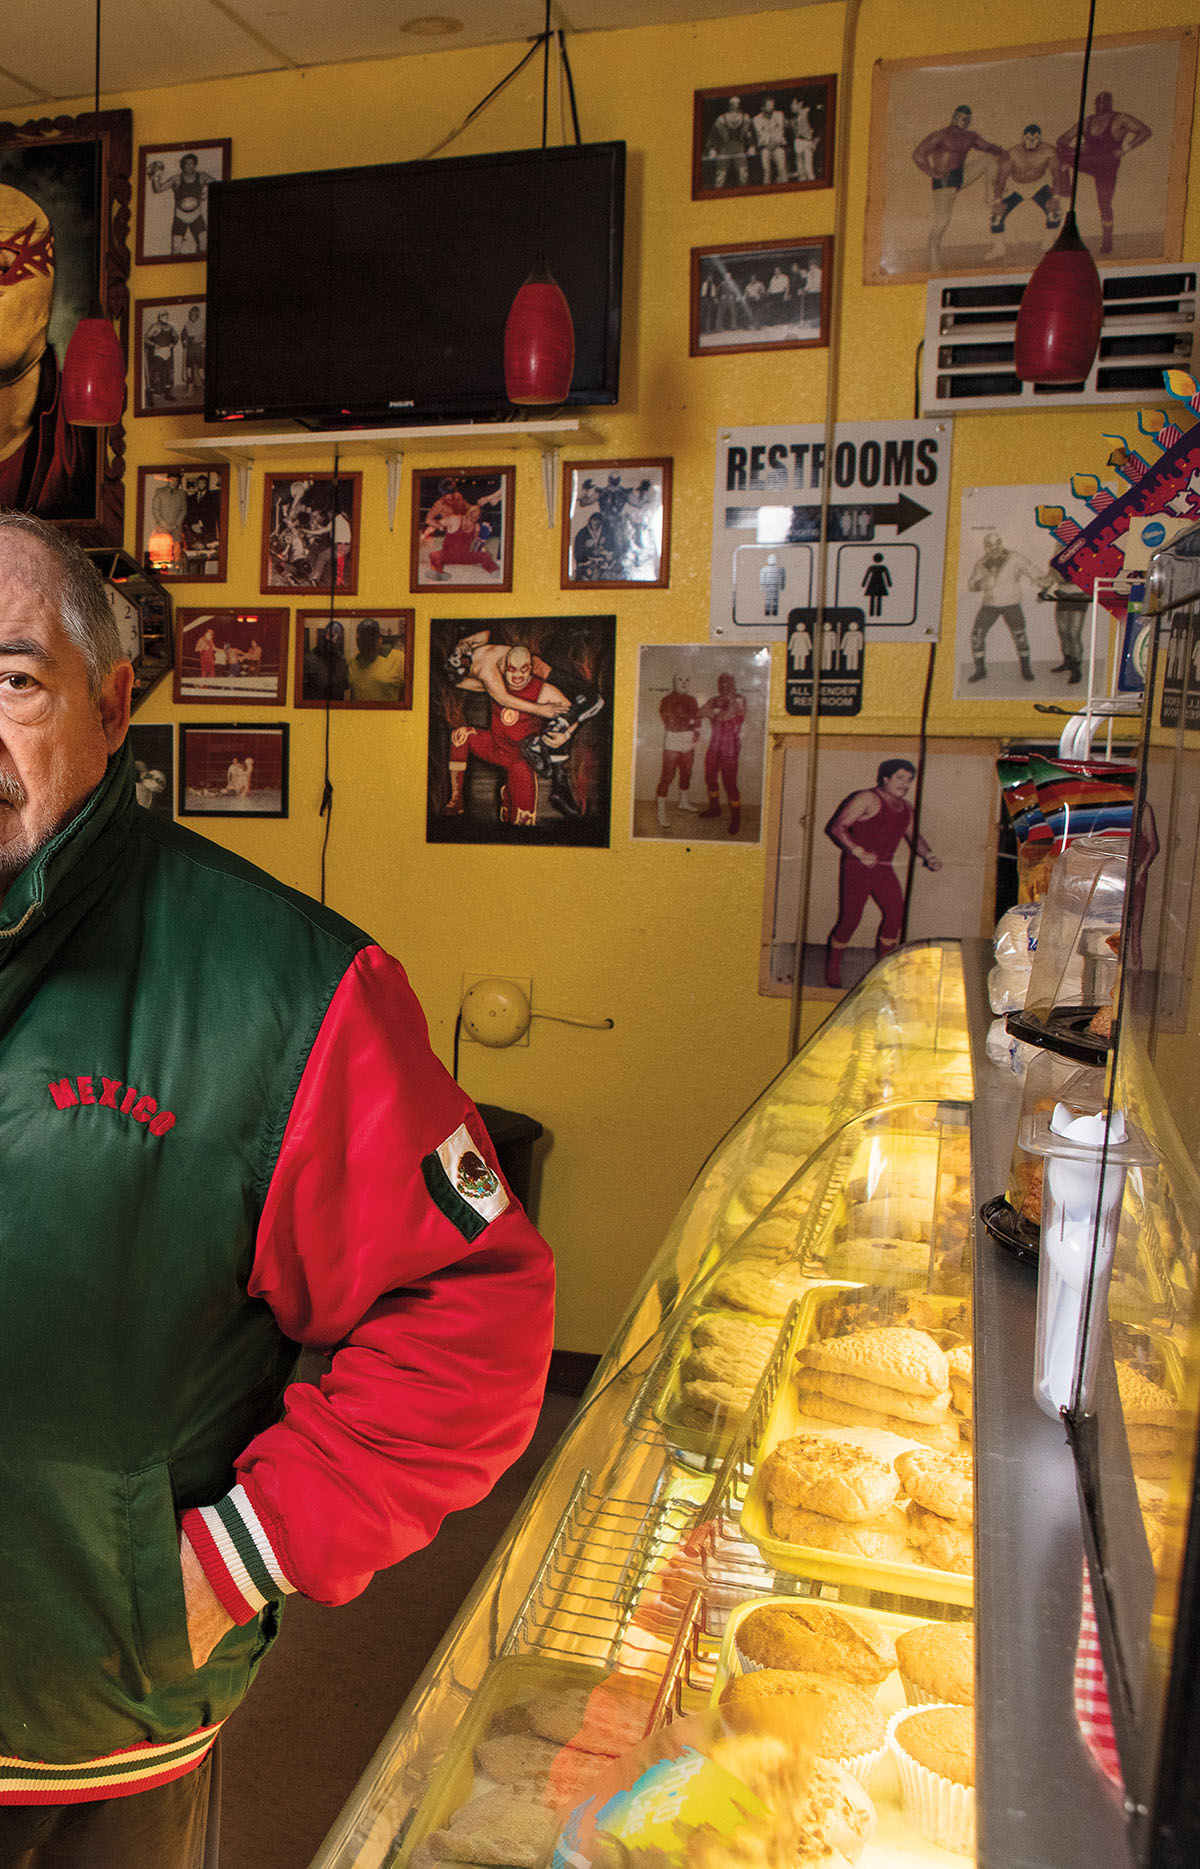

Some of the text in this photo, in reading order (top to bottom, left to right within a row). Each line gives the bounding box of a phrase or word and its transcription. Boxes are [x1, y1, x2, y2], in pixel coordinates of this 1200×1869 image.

[726, 438, 939, 491] RESTROOMS
[124, 606, 131, 619] 2
[131, 625, 137, 639] 3
[793, 697, 854, 706] RESROOM
[48, 1076, 176, 1136] MEXICO
